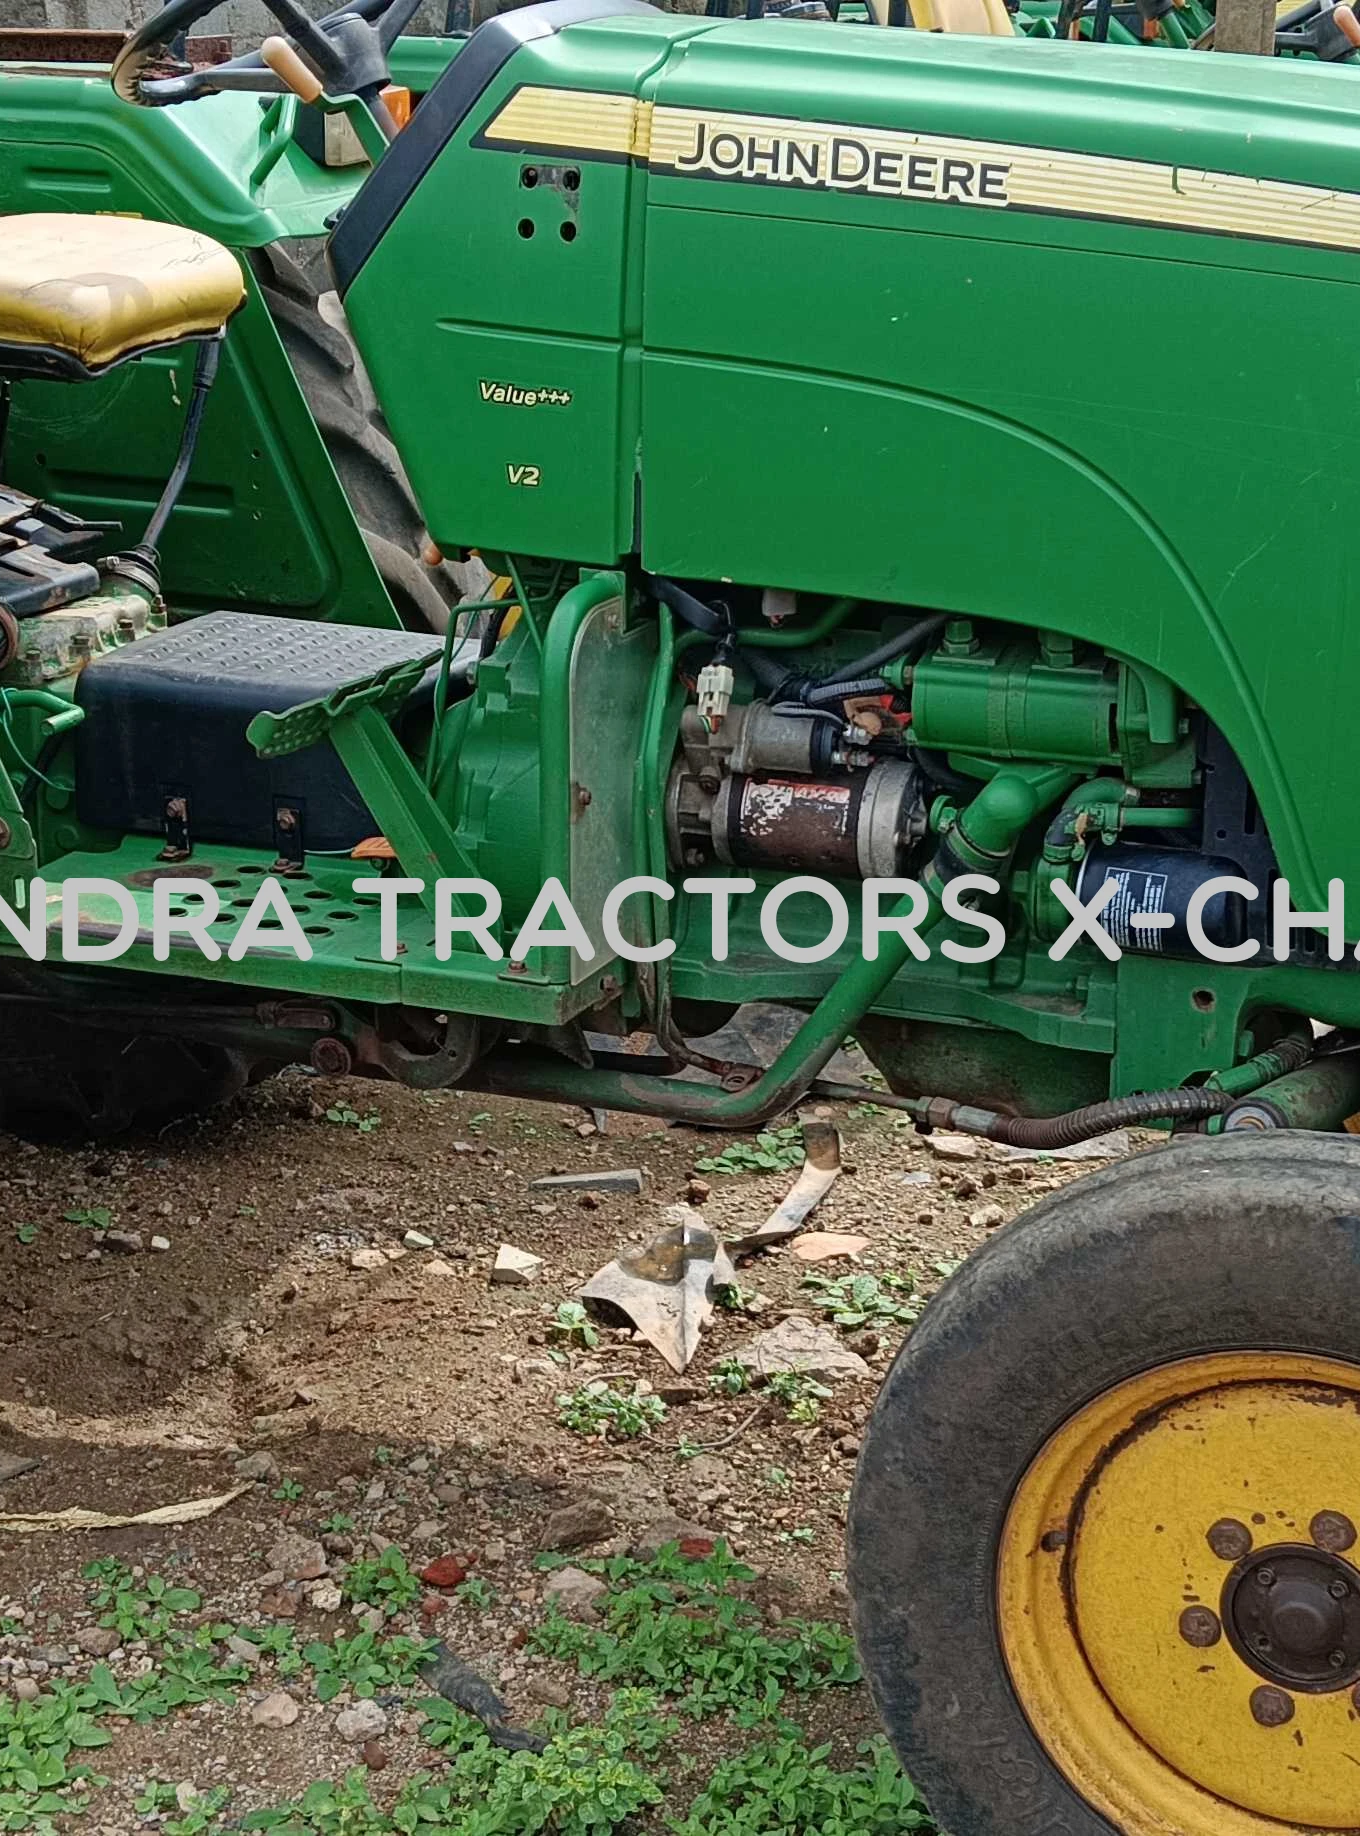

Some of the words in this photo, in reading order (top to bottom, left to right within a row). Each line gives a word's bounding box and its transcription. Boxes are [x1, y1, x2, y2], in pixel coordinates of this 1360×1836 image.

[677, 123, 820, 178] JOHN
[830, 137, 1013, 201] DEERE
[507, 463, 541, 486] V2
